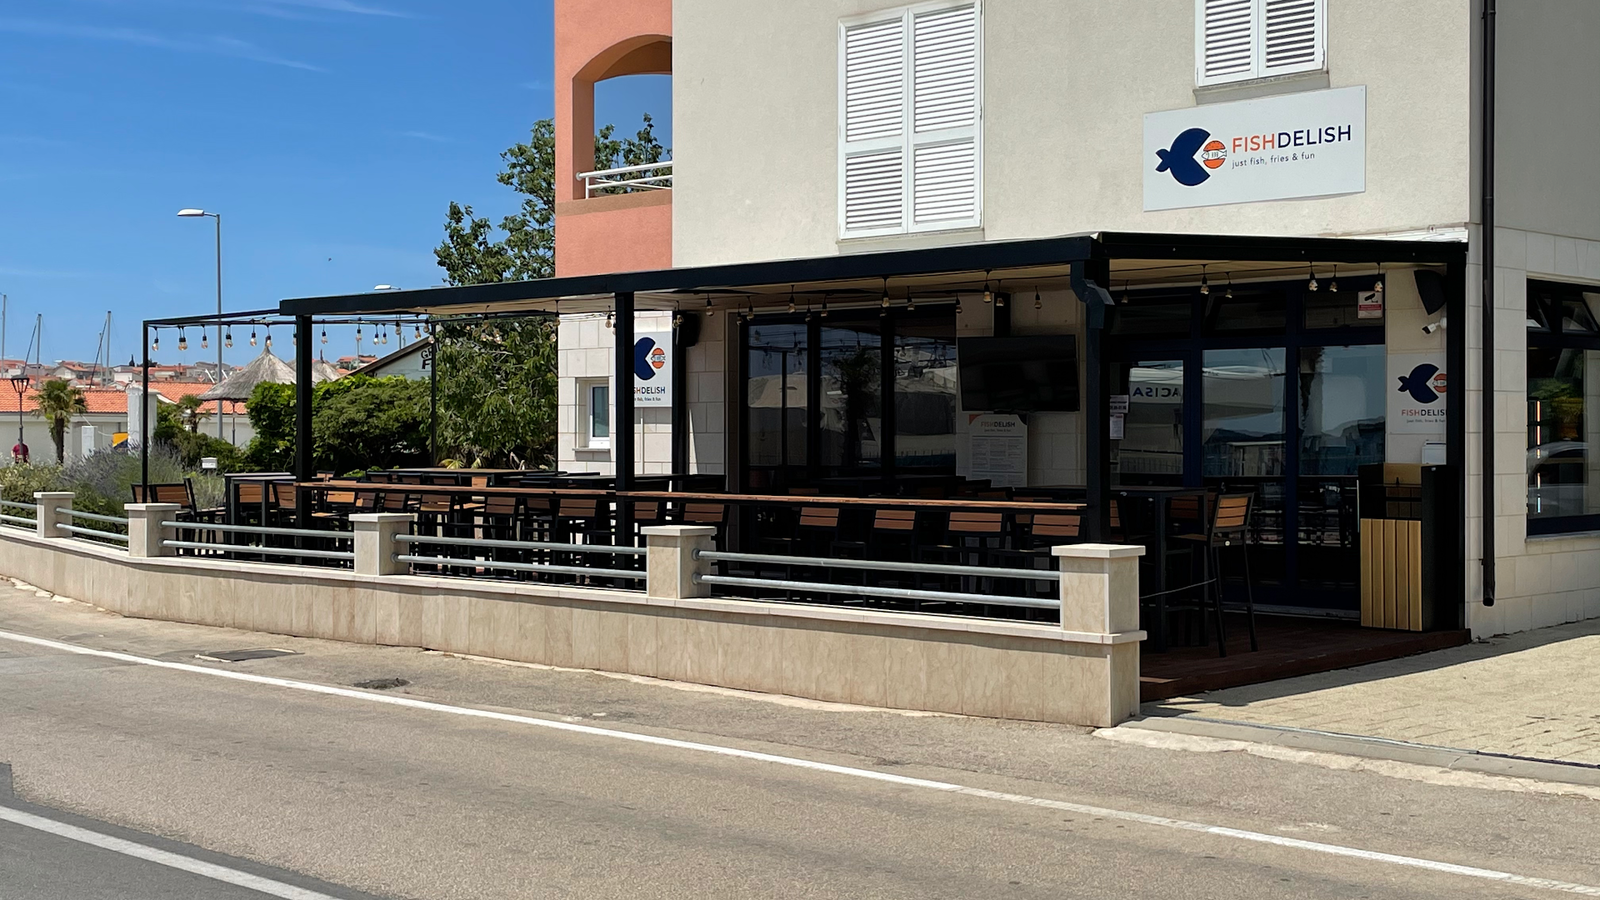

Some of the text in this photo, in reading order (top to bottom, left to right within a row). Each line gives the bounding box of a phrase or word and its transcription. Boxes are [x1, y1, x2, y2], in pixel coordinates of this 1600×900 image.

[1232, 124, 1351, 154] FISHDELISH
[1231, 151, 1315, 170] just fish, fries & fun
[634, 386, 666, 395] SHDELISH
